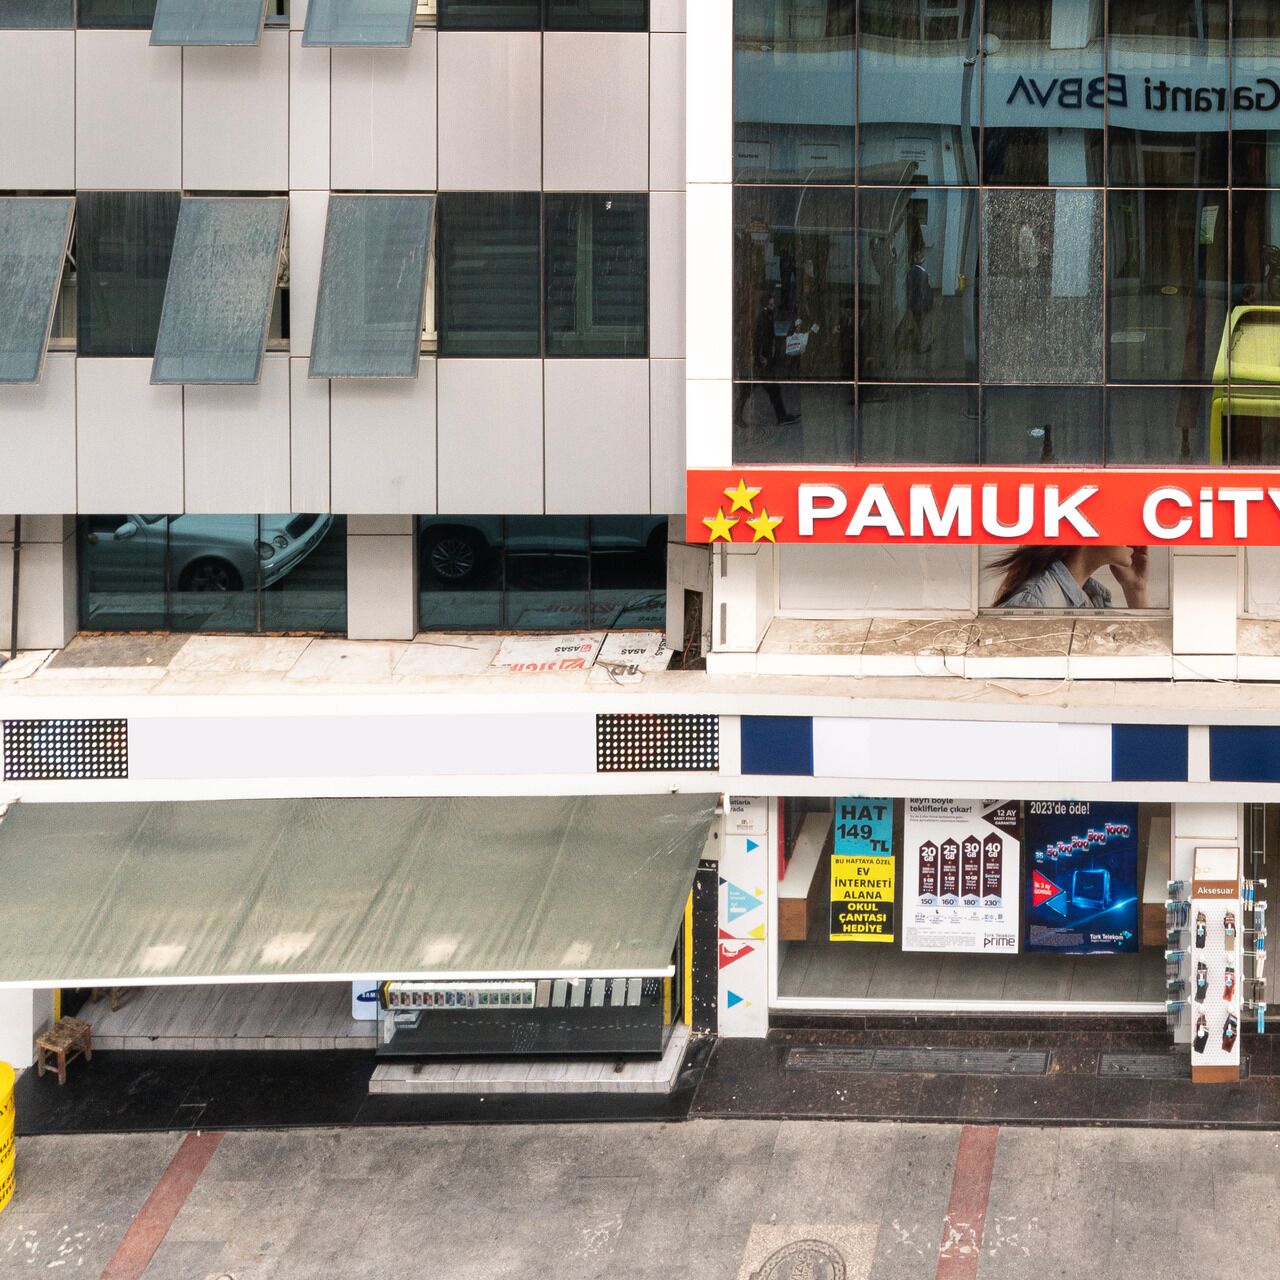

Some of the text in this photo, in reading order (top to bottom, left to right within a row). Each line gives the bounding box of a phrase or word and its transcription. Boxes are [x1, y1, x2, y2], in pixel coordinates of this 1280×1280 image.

[797, 483, 1100, 538] PAMUK
[841, 805, 888, 821] HAT
[950, 806, 972, 814] çıkar!
[1030, 801, 1090, 815] 2023'de öde!
[837, 824, 873, 840] 149
[870, 839, 889, 852] TL
[943, 845, 957, 854] 25
[964, 843, 979, 852] 30
[985, 843, 1000, 852] 40
[921, 847, 936, 857] 20
[875, 857, 891, 865] ÖZEL
[857, 867, 870, 876] EV
[834, 877, 892, 889] İNTERNETİ
[843, 891, 882, 900] ALANA
[1197, 887, 1234, 895] Aksesuar
[847, 902, 878, 911] OKUL
[838, 913, 887, 923] ÇANTASI
[843, 923, 882, 933] HEDİYE
[984, 937, 1015, 948] prime
